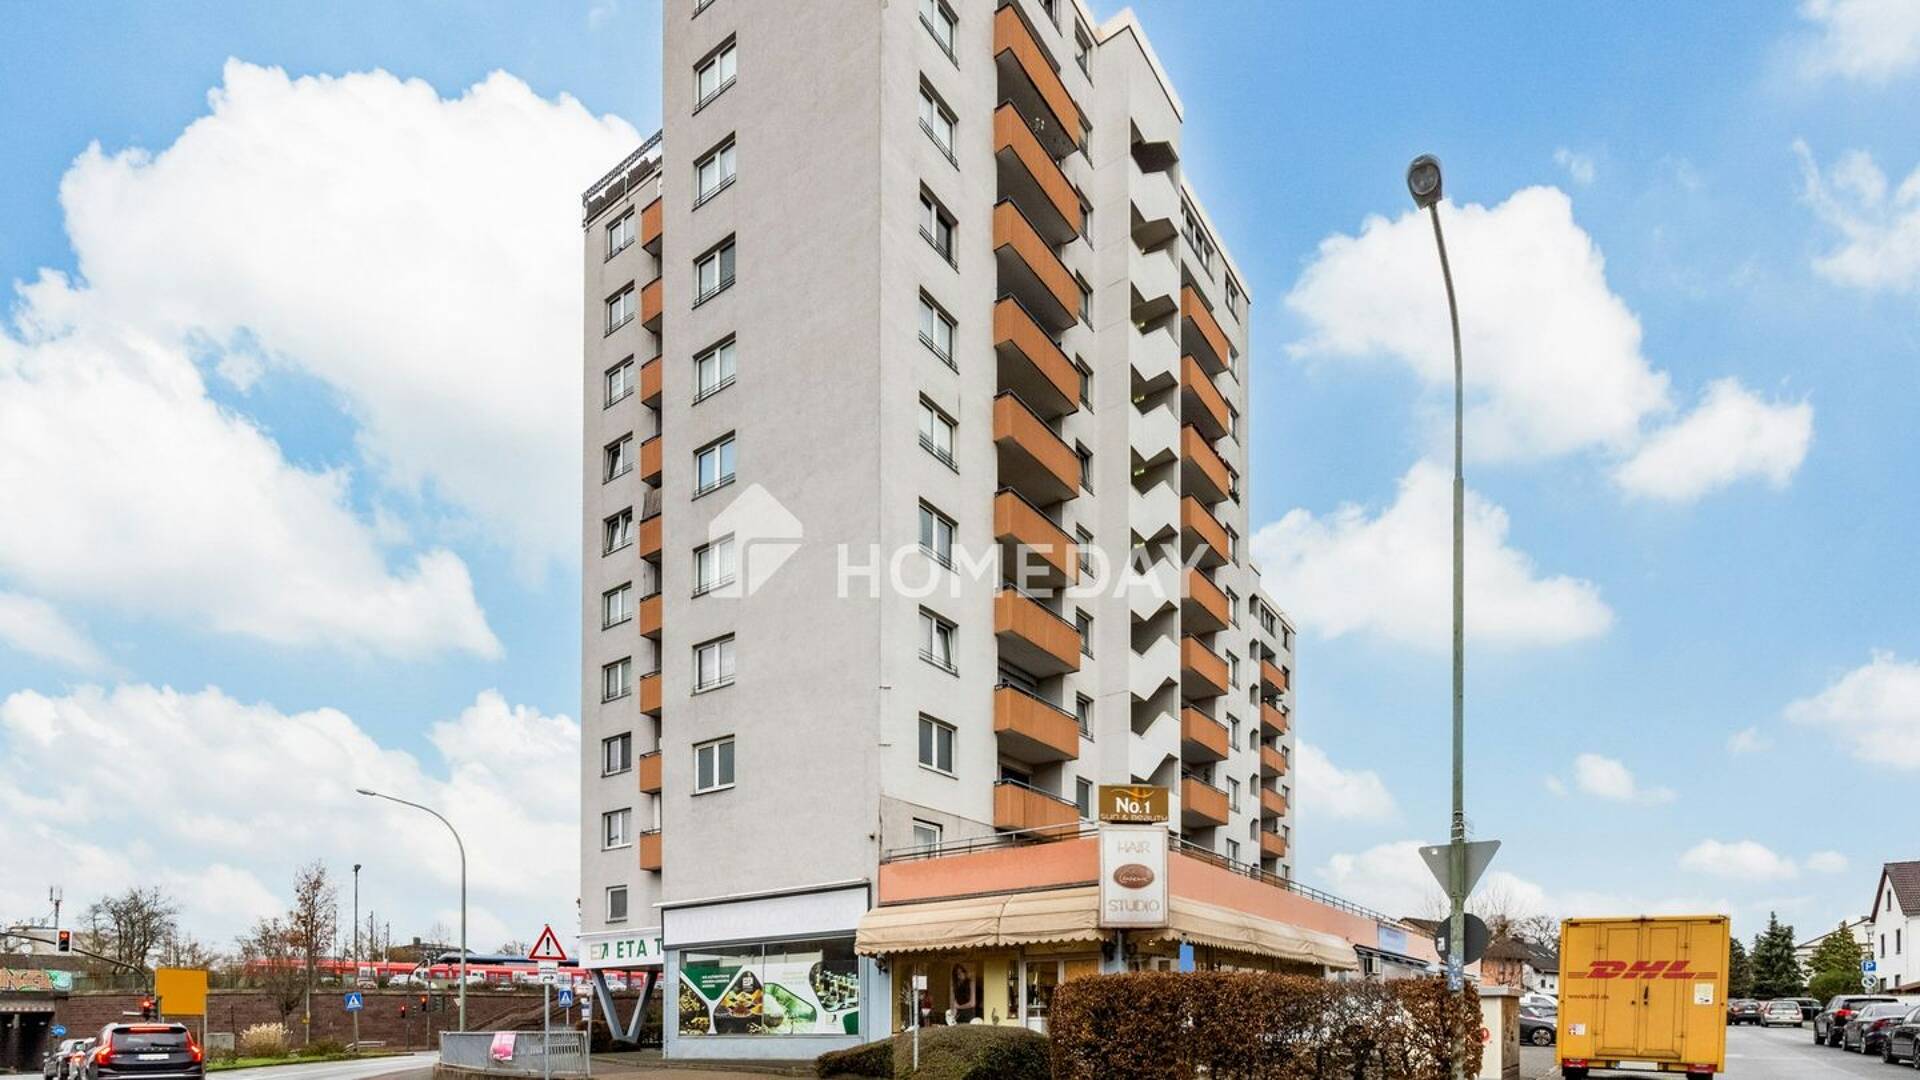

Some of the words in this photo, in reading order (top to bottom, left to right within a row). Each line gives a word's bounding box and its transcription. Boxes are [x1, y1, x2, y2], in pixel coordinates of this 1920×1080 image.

[1115, 796, 1151, 814] No.1
[1118, 840, 1151, 854] HAIR
[1108, 899, 1161, 912] STUDIO
[616, 939, 647, 959] ETA
[1587, 960, 1696, 979] DHL
